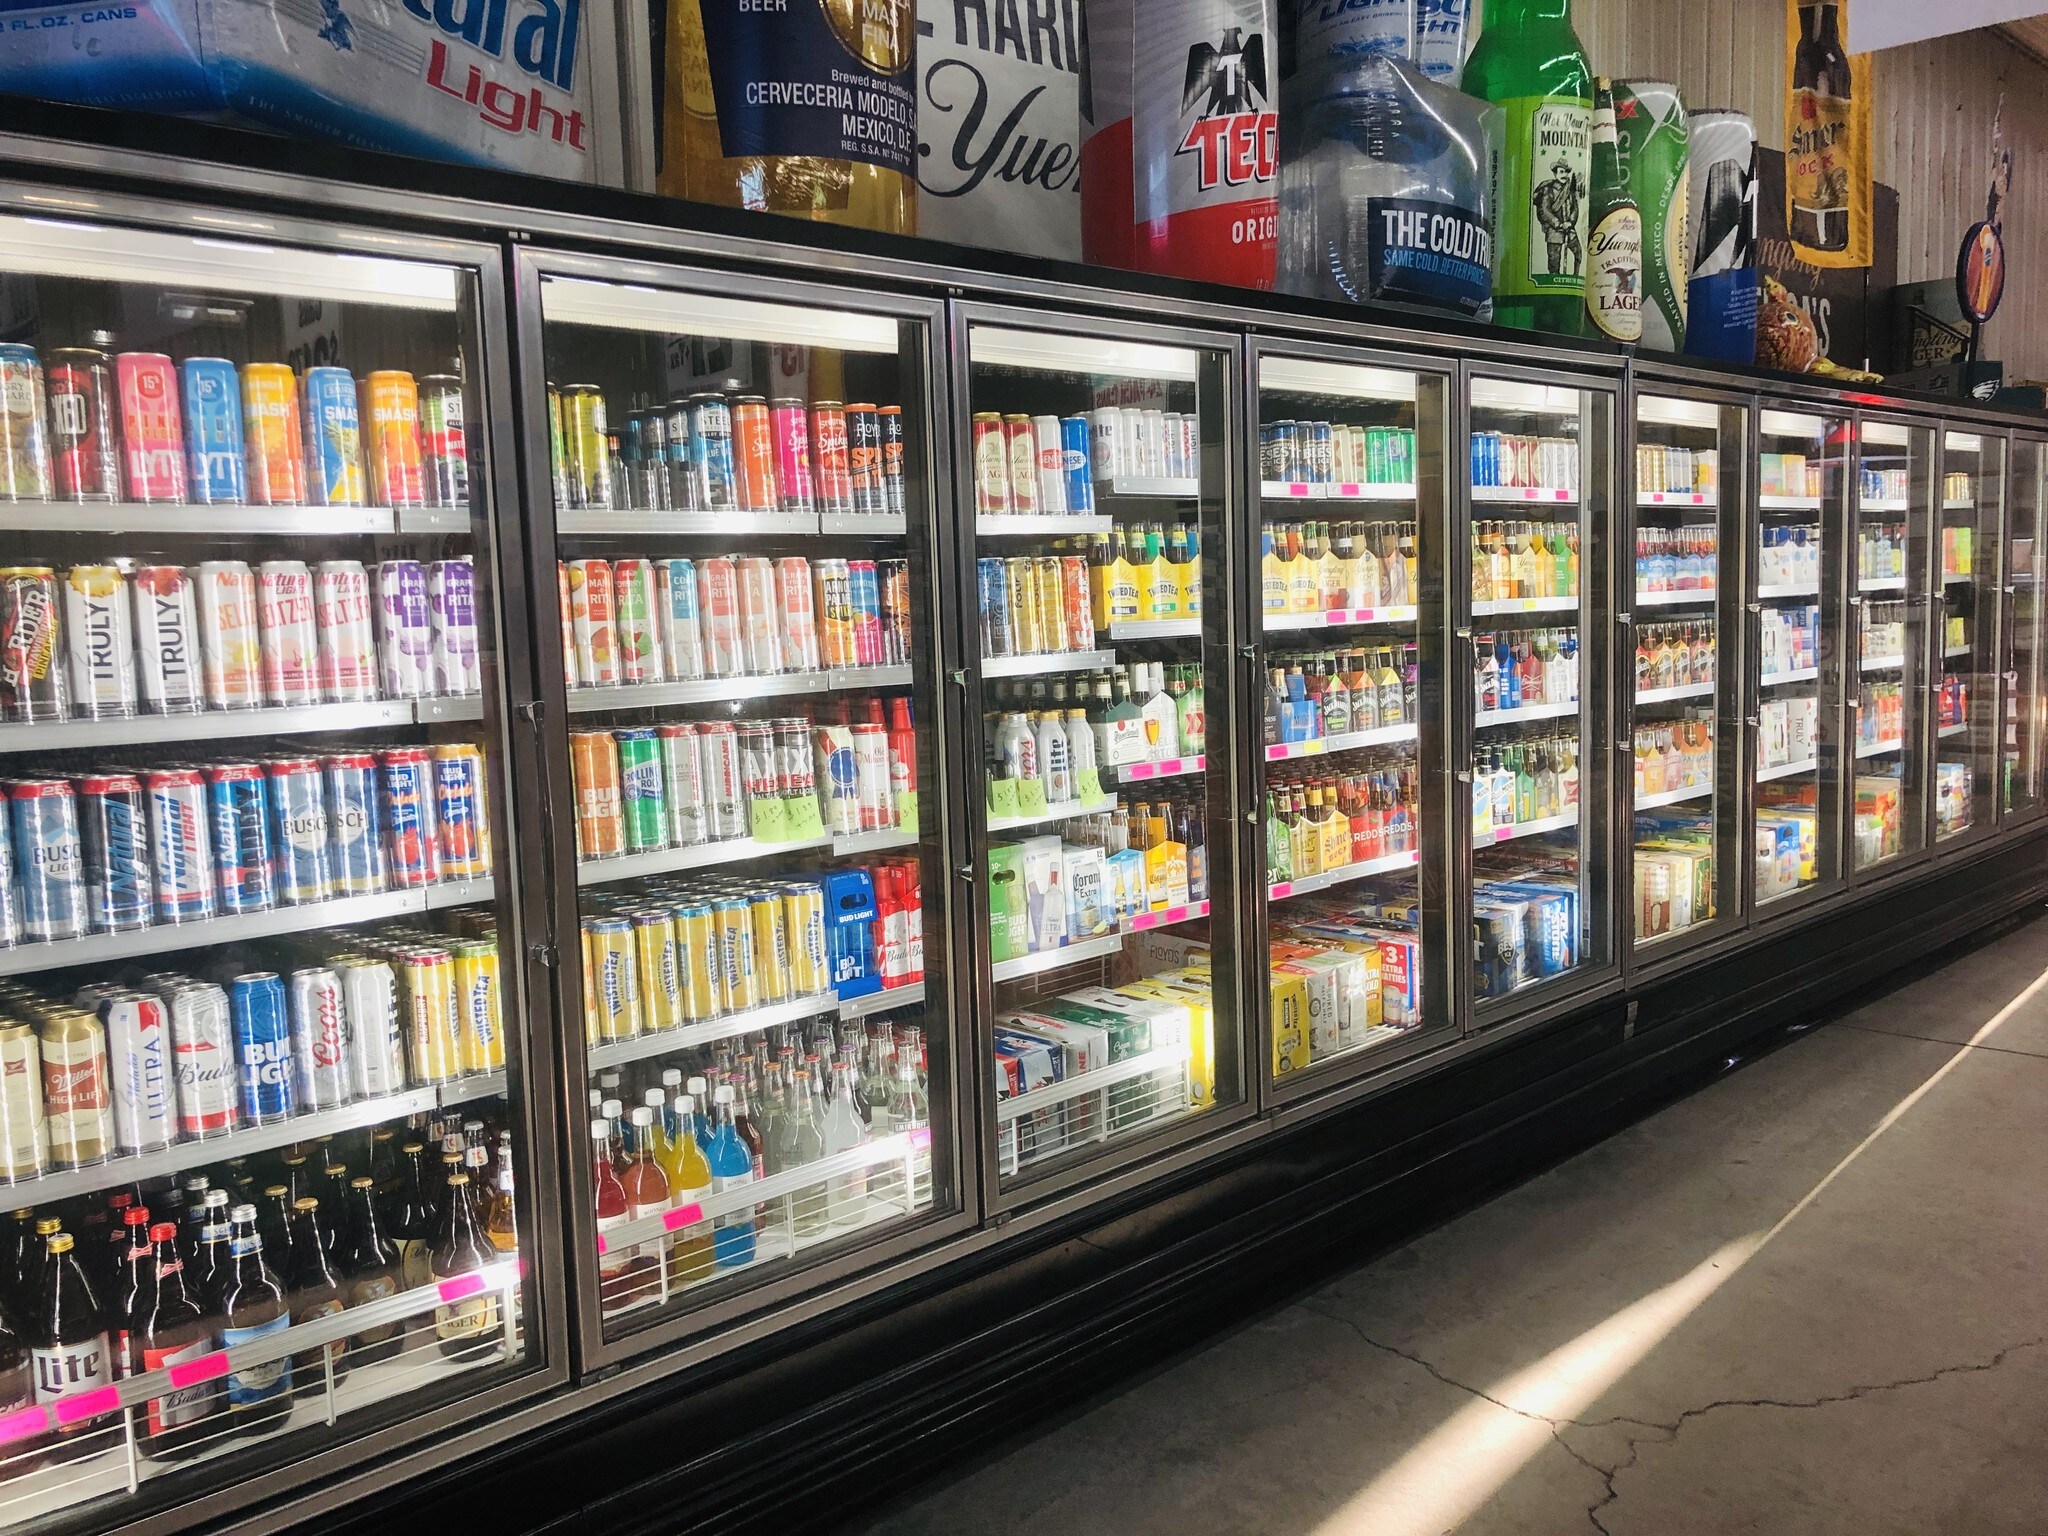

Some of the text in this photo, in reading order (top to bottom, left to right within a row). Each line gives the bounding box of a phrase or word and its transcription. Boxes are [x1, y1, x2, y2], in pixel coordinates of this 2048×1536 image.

[82, 7, 137, 24] CANS
[862, 23, 899, 53] FINA
[427, 38, 586, 152] Light
[746, 82, 853, 110] CERVECERIA
[831, 69, 870, 88] Brewed
[871, 78, 887, 92] and
[888, 82, 909, 101] bottled
[842, 113, 897, 150] MEXICO,
[841, 140, 859, 152] REG.
[1381, 209, 1428, 249] THE
[1430, 214, 1474, 260] COLD
[1653, 221, 1664, 267] MEXICO
[1383, 248, 1415, 268] SAME
[1440, 256, 1468, 281] BETTER
[374, 407, 418, 422] SMASH
[402, 594, 427, 607] RITA
[448, 594, 474, 607] RITA
[1128, 587, 1139, 600] TEA
[1167, 586, 1179, 597] TEA
[86, 601, 114, 680] TRULY
[157, 598, 187, 681] TRULY
[1795, 716, 1804, 745] TRULY
[721, 738, 733, 799] HURRICANE
[180, 801, 198, 852] LIGHT
[1354, 827, 1383, 843] REDD'S
[1383, 821, 1413, 836] REDD'S
[104, 797, 137, 896] Natural
[1080, 889, 1097, 899] Extra
[838, 909, 874, 924] BUD LIGHT
[1008, 914, 1026, 927] BUD
[1385, 945, 1398, 963] 3
[1382, 964, 1403, 975] EXTRA
[312, 985, 342, 1069] Coors
[52, 1066, 95, 1093] Miller
[144, 1036, 164, 1121] ULTRA
[894, 1121, 928, 1132] SMIRNOFF
[38, 1350, 99, 1394] Lite
